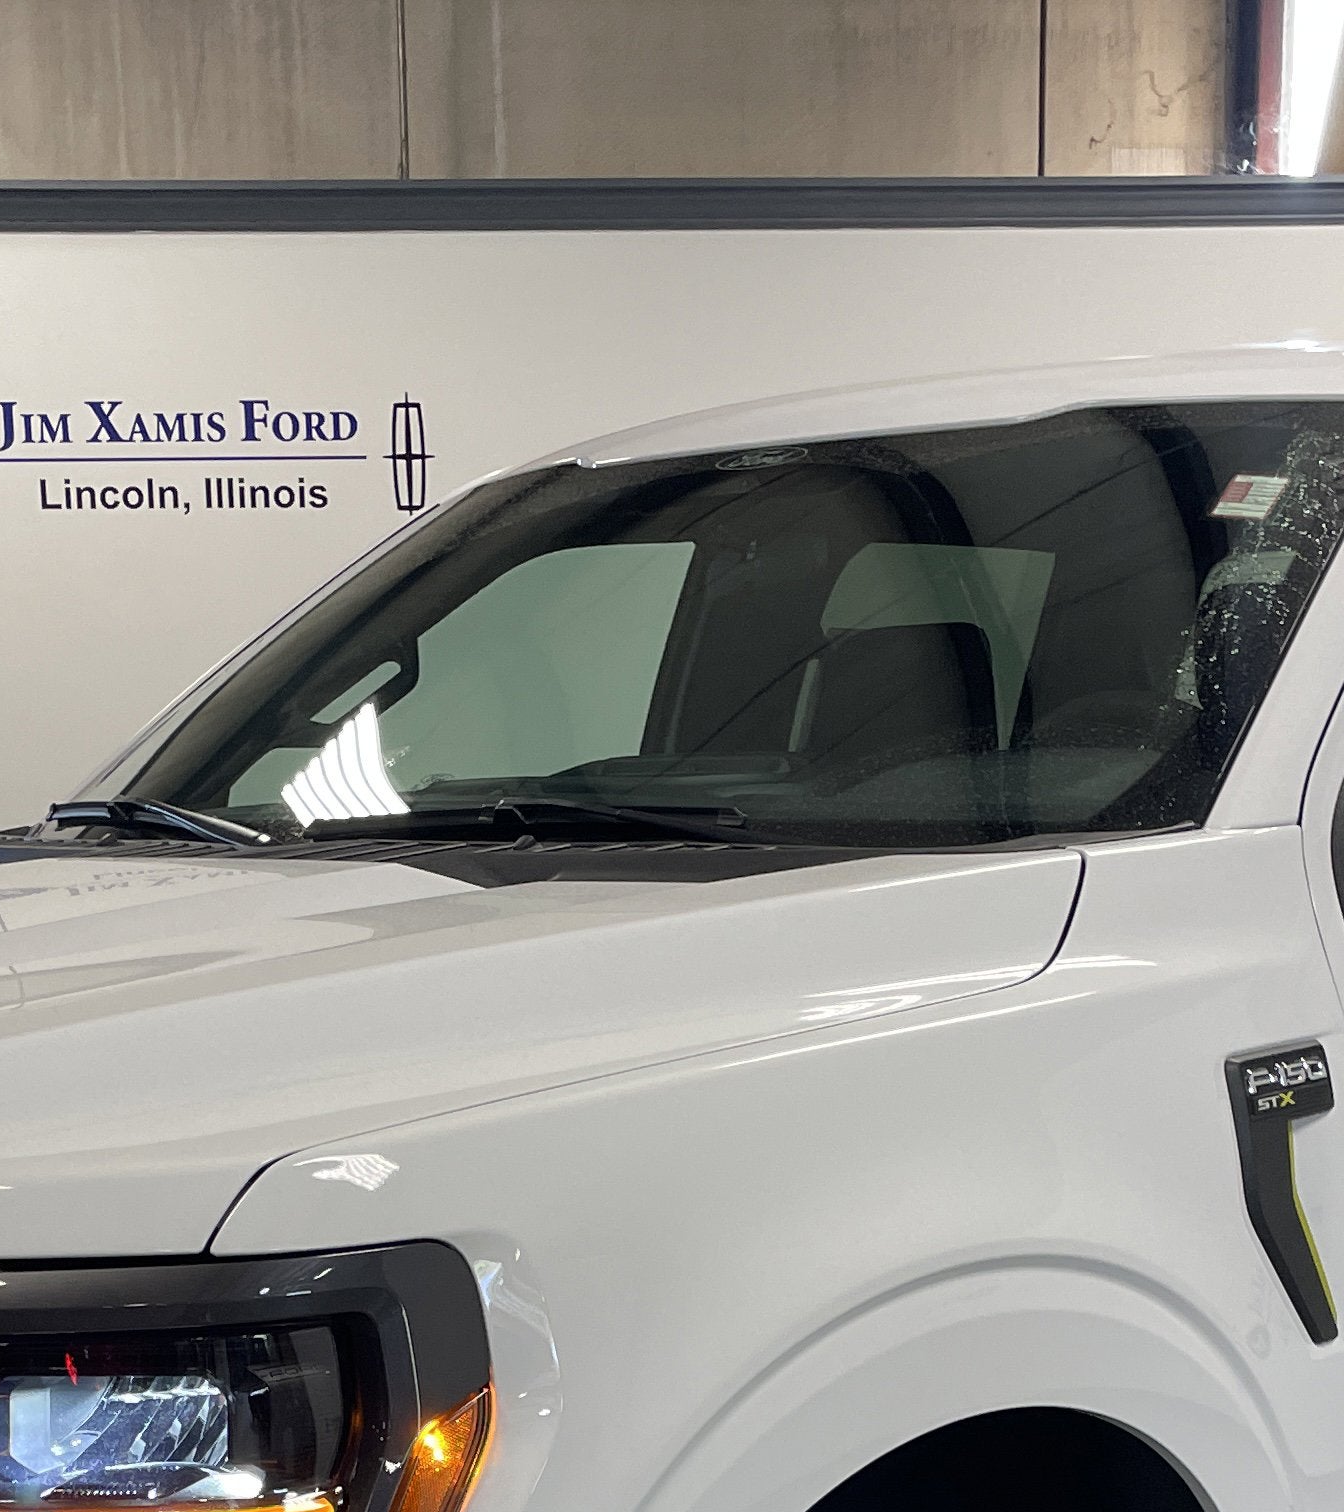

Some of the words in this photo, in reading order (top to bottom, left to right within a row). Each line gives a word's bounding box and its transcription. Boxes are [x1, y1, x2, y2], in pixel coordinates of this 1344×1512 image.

[85, 400, 226, 443] XAMIS
[240, 400, 358, 442] FORD
[39, 478, 192, 514] Lincoln,
[205, 477, 329, 510] Illinois
[1258, 1091, 1296, 1111] STX
